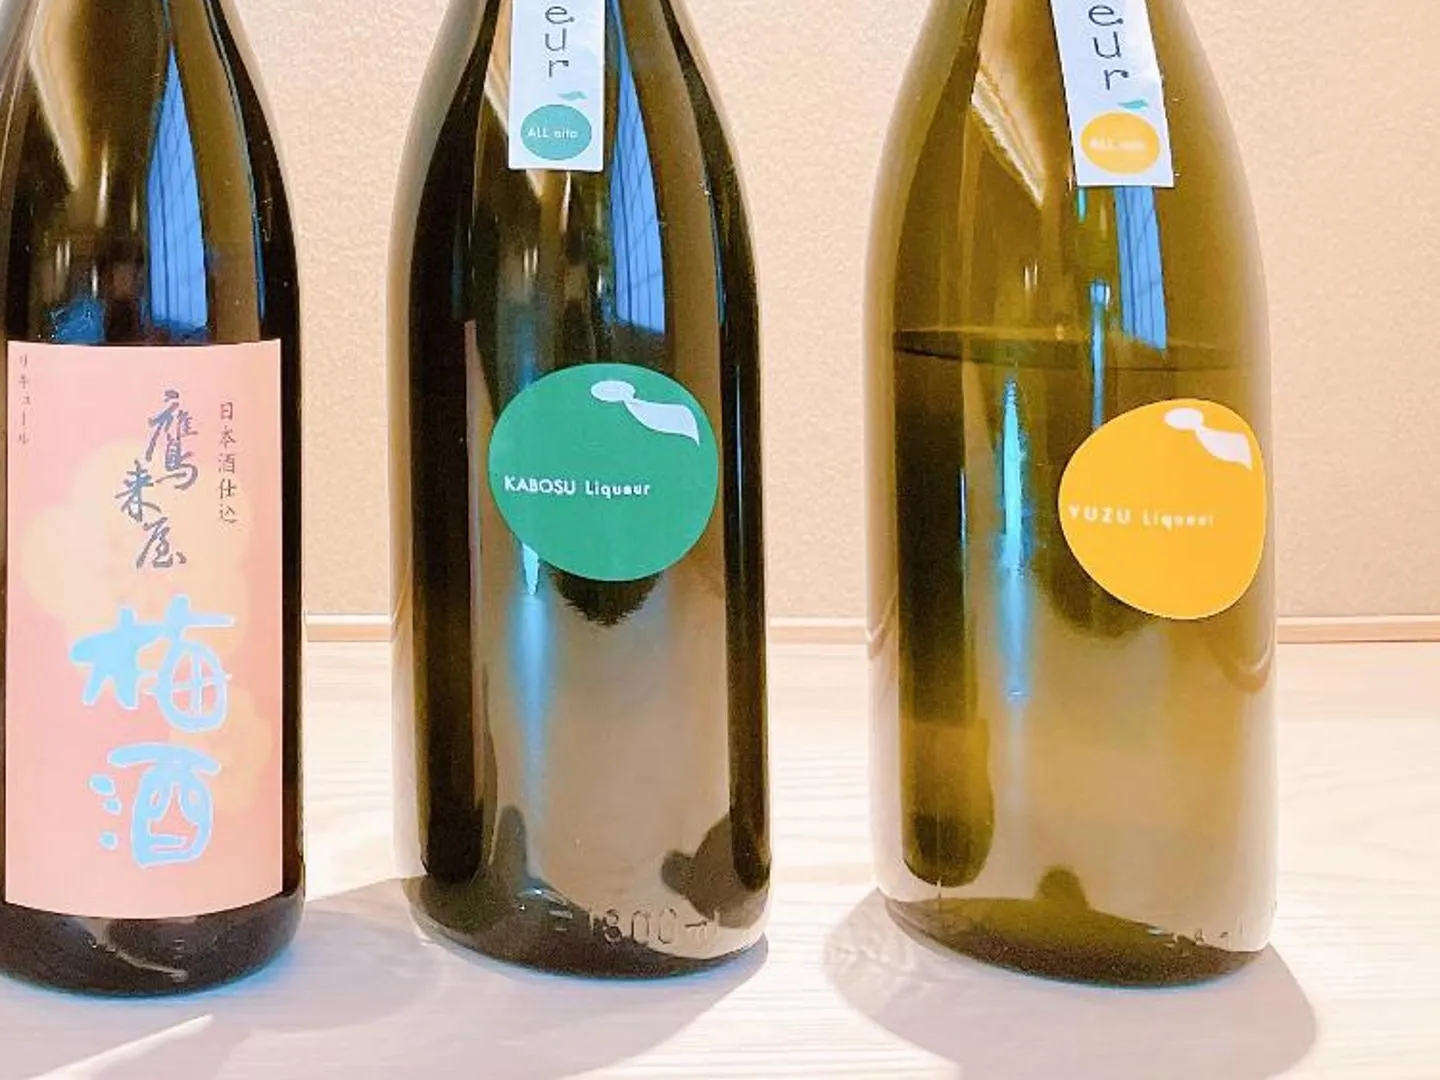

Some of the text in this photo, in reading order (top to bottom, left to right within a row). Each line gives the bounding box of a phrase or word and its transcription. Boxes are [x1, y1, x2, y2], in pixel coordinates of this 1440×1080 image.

[218, 401, 238, 525] 日本酒仕込
[503, 475, 651, 500] KABOSU Liqueur
[1068, 504, 1133, 526] YUZU
[69, 592, 235, 869] 梅酒
